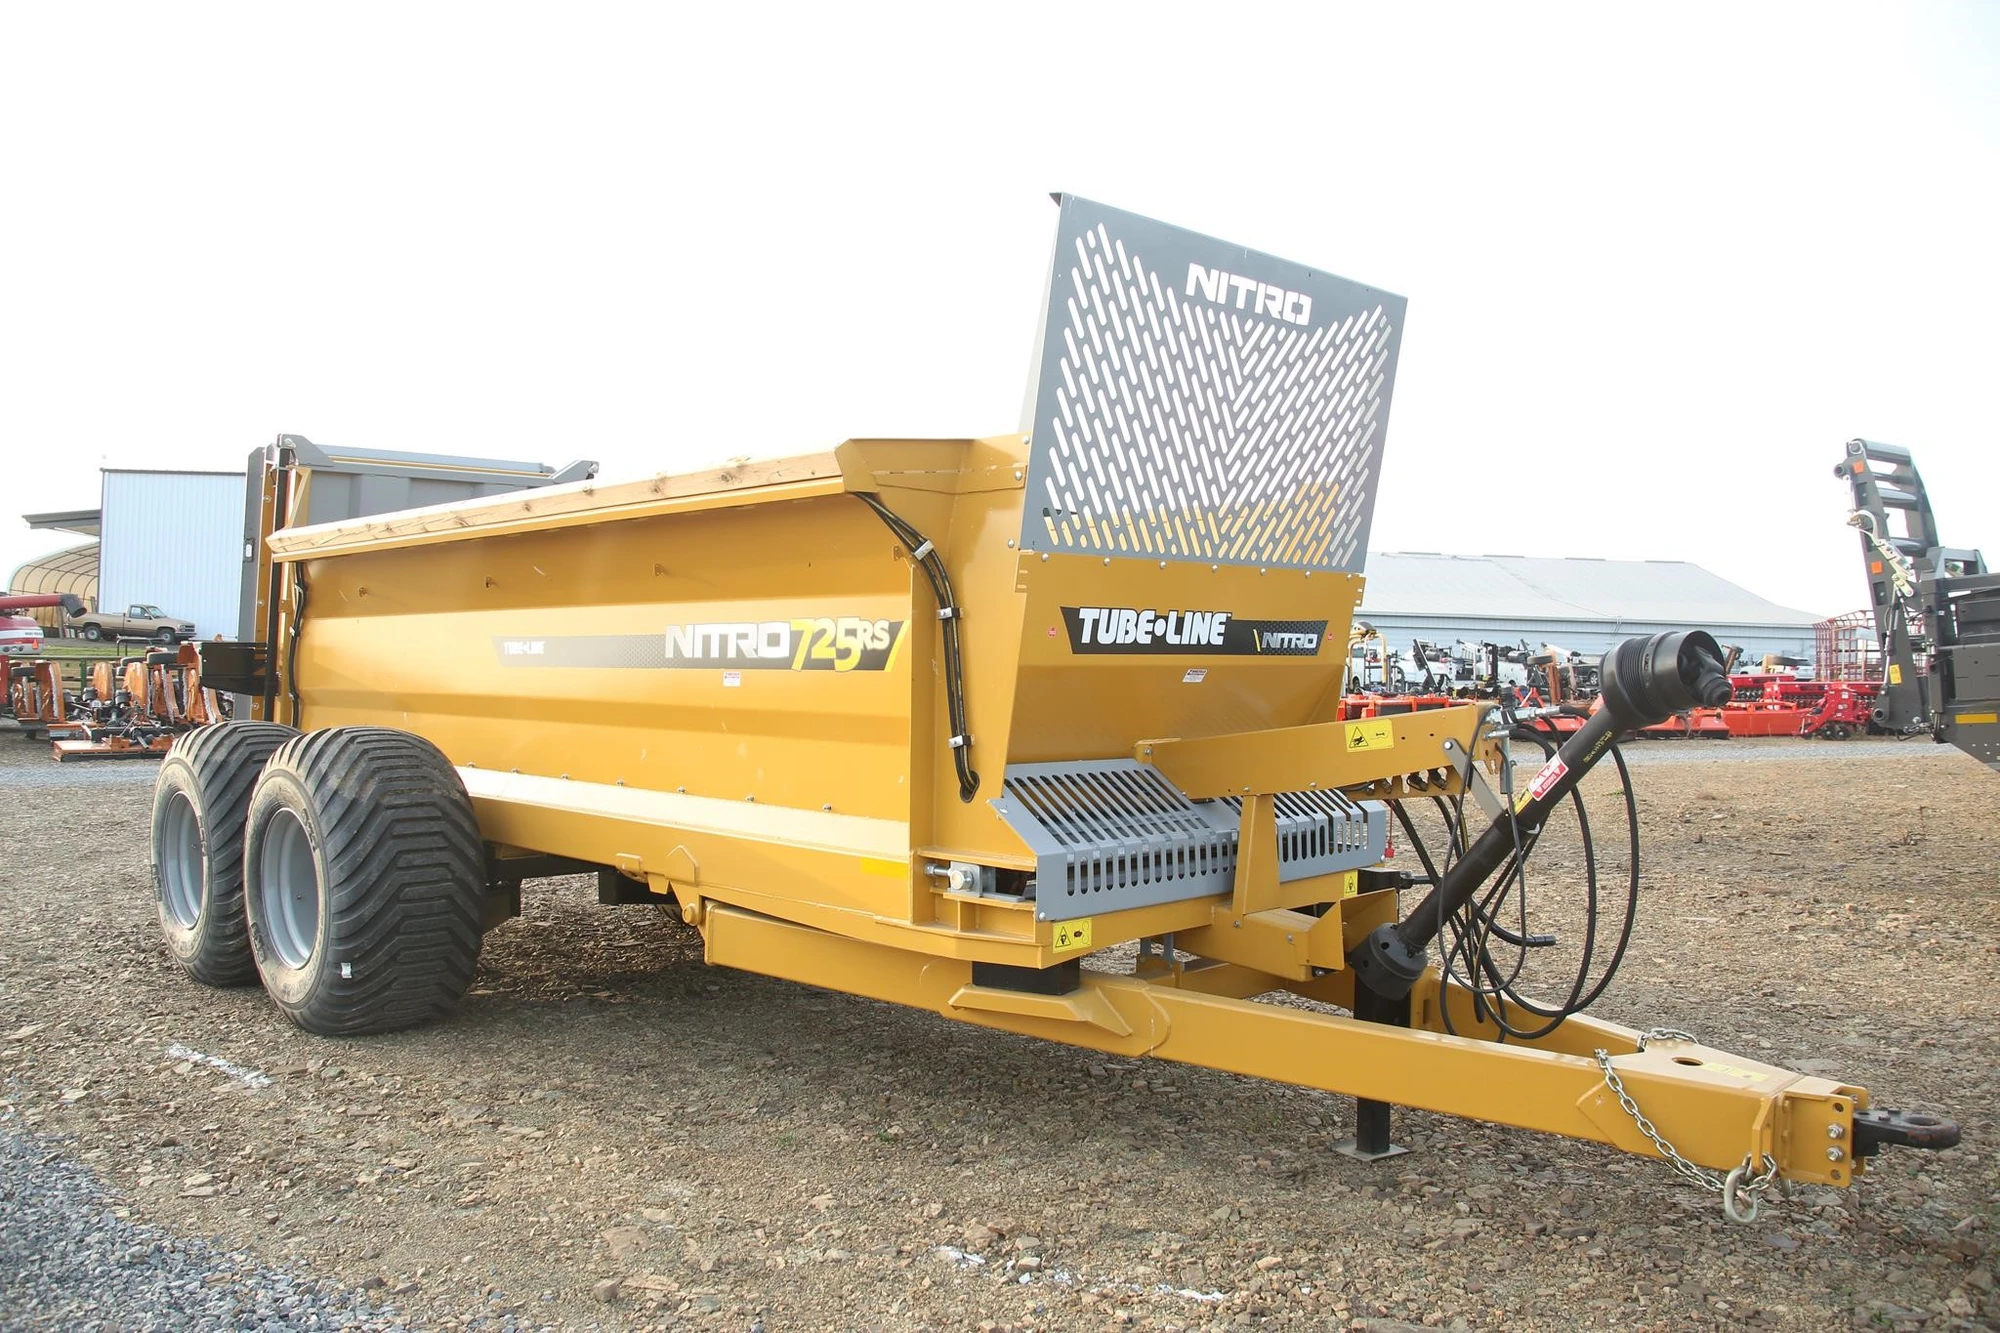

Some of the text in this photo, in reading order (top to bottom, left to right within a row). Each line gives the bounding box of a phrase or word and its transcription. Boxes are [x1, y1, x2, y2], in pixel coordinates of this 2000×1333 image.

[1185, 262, 1313, 327] NITRO
[664, 622, 790, 659] NITRO
[1261, 632, 1318, 649] NITRO
